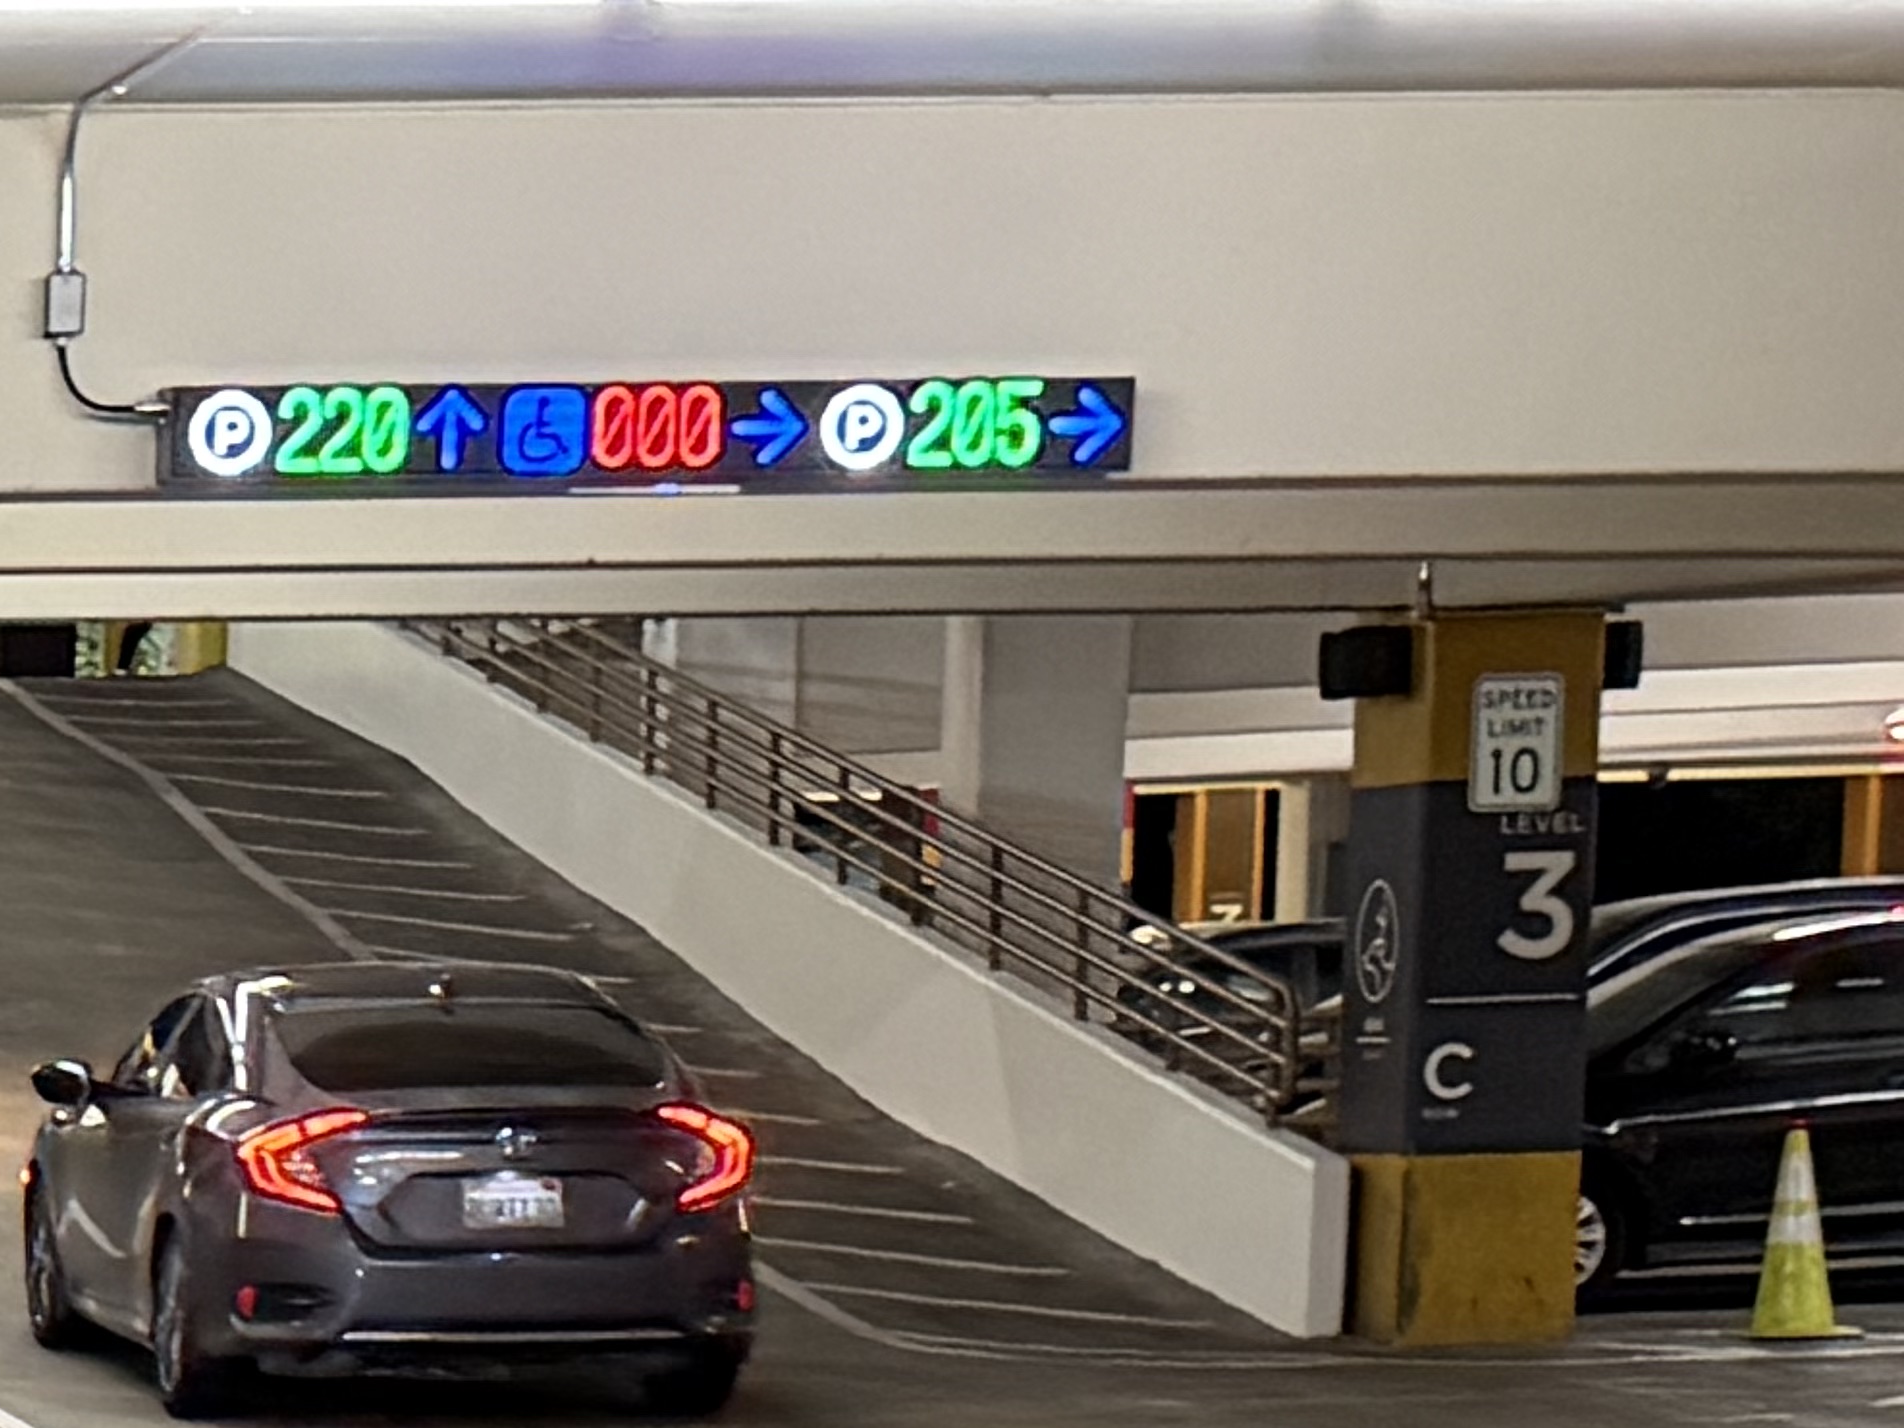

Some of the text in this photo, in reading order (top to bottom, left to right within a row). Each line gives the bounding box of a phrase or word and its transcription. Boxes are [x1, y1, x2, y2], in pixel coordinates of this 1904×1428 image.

[275, 386, 410, 474] 220
[592, 384, 721, 469] 000
[906, 379, 1045, 468] 205
[1483, 687, 1558, 710] SPEED
[1487, 716, 1545, 738] LIMIT
[1491, 746, 1539, 796] 10
[1500, 810, 1587, 836] LEVEL
[1496, 850, 1576, 960] 3
[1423, 1041, 1474, 1100] C
